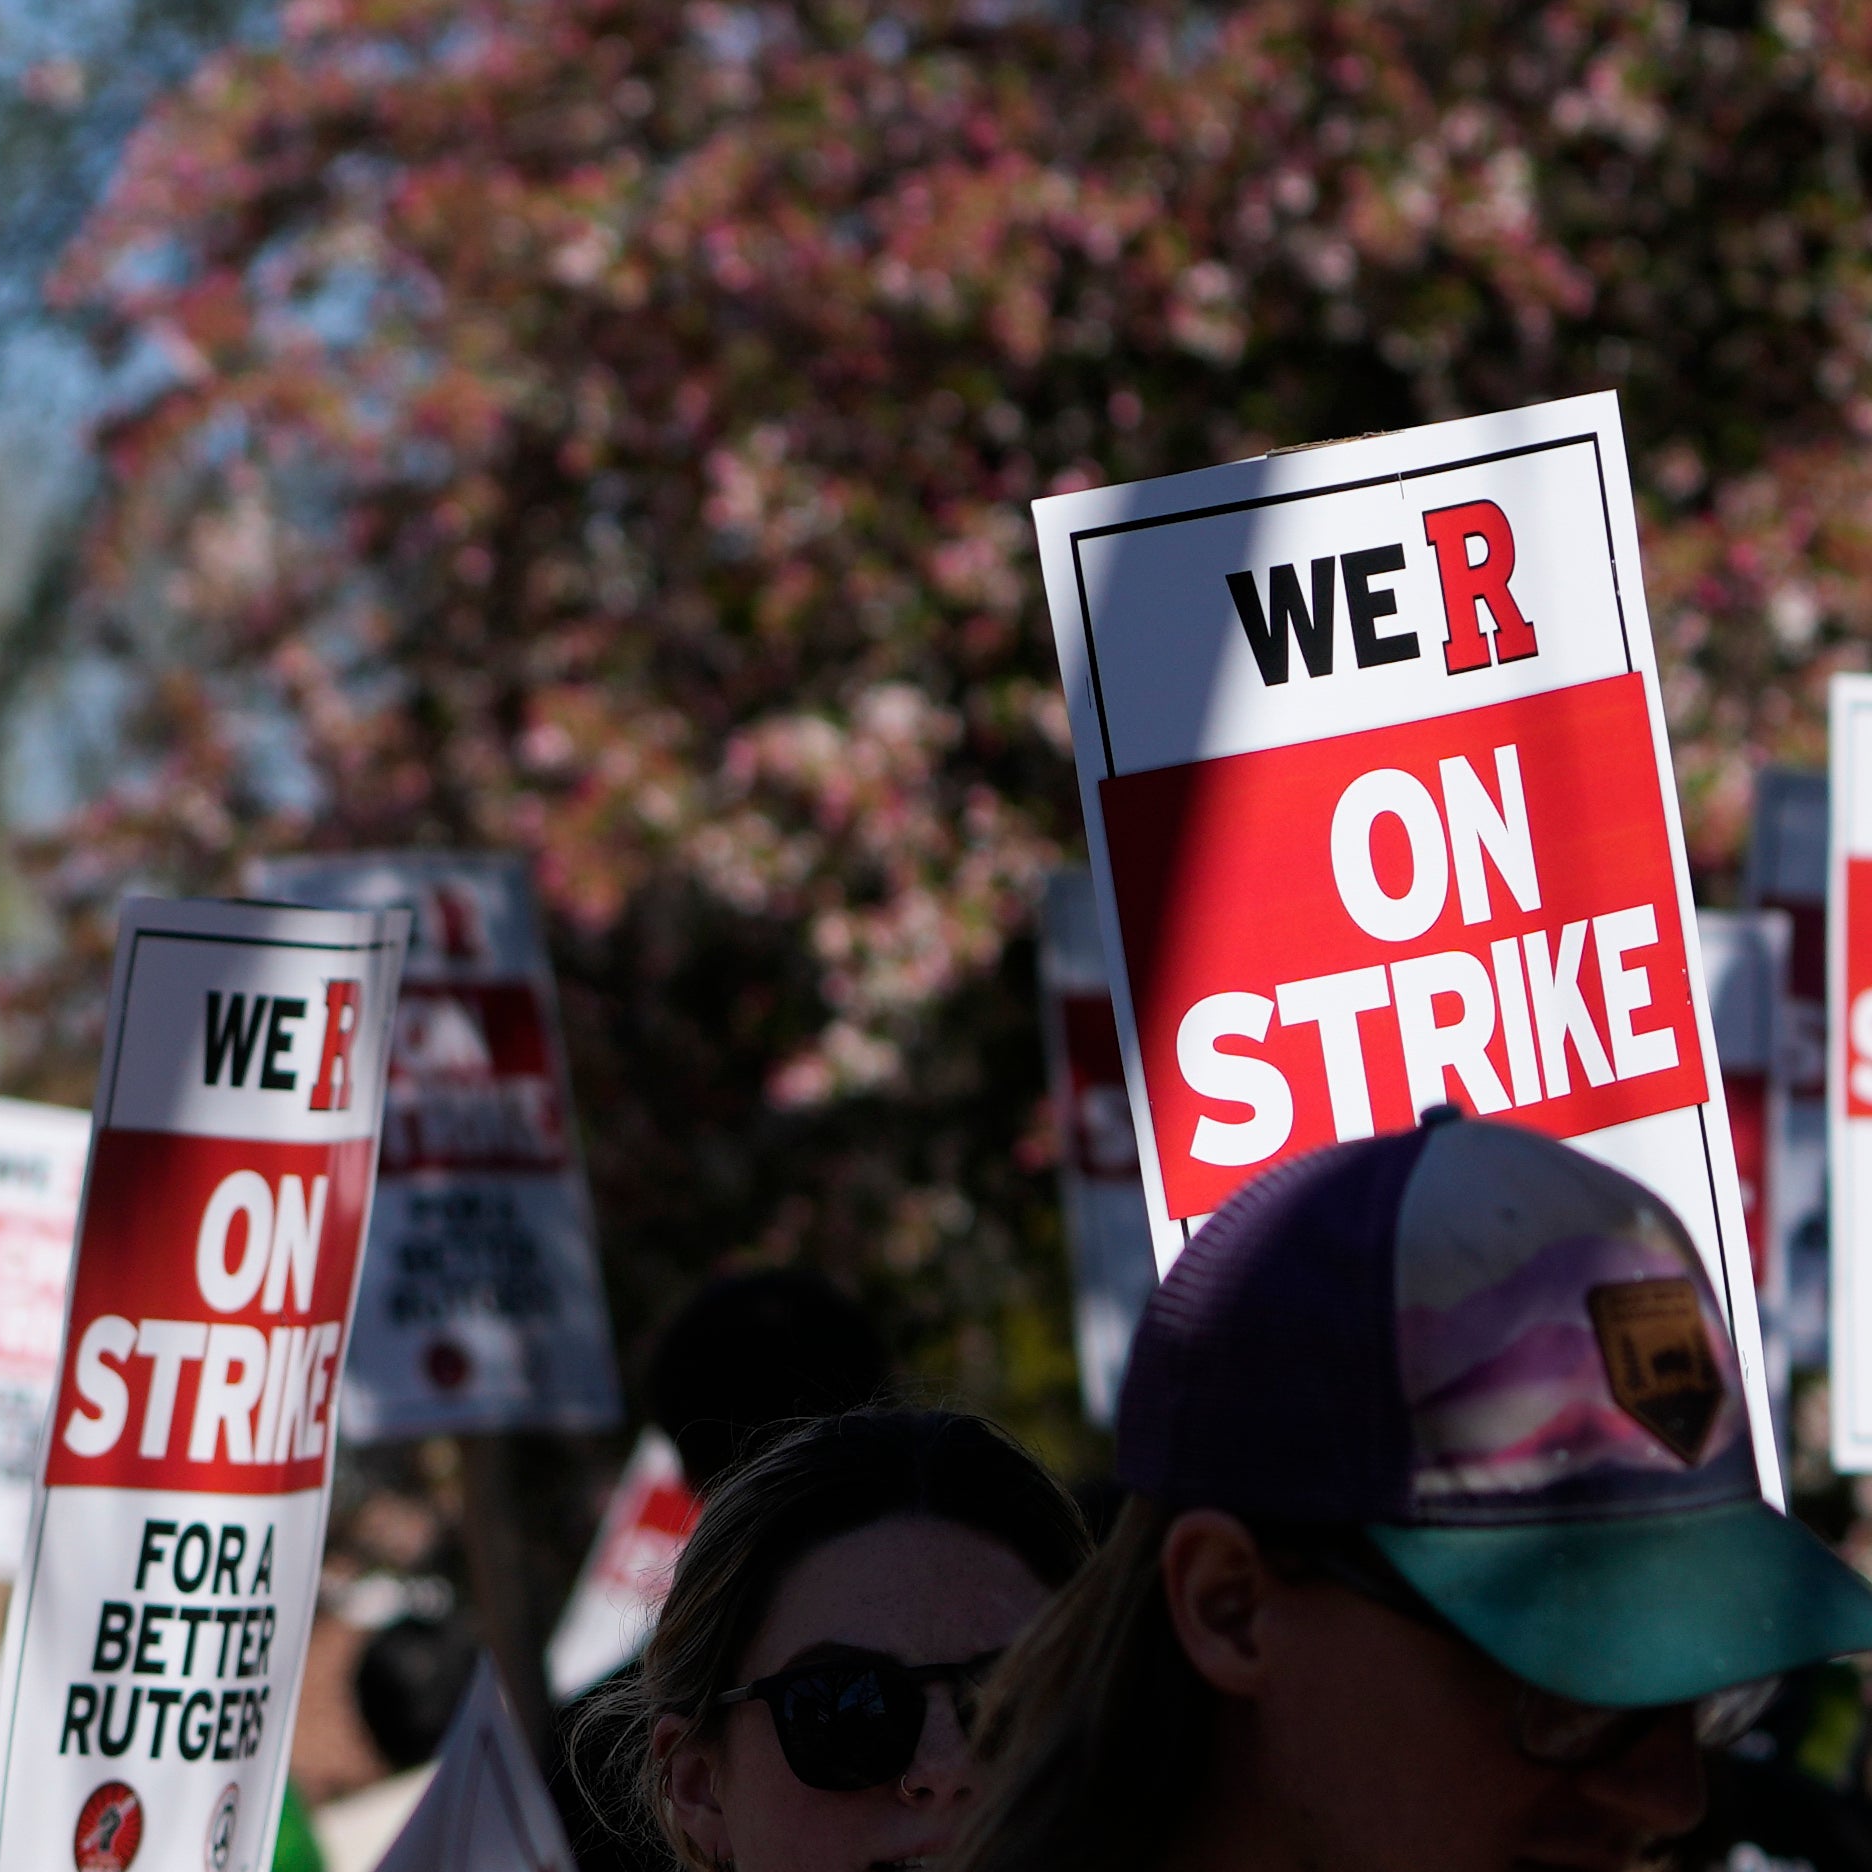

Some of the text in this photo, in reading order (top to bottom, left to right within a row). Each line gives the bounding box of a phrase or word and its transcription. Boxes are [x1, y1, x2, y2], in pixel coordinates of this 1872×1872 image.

[1225, 498, 1539, 686] WE R
[1330, 744, 1542, 943] ON
[203, 978, 361, 1111] WE R
[1175, 903, 1680, 1166] STRIKE
[196, 1169, 329, 1315] ON
[63, 1314, 342, 1468] STRIKE
[134, 1519, 275, 1596] FOR A
[92, 1600, 276, 1679] BETTER
